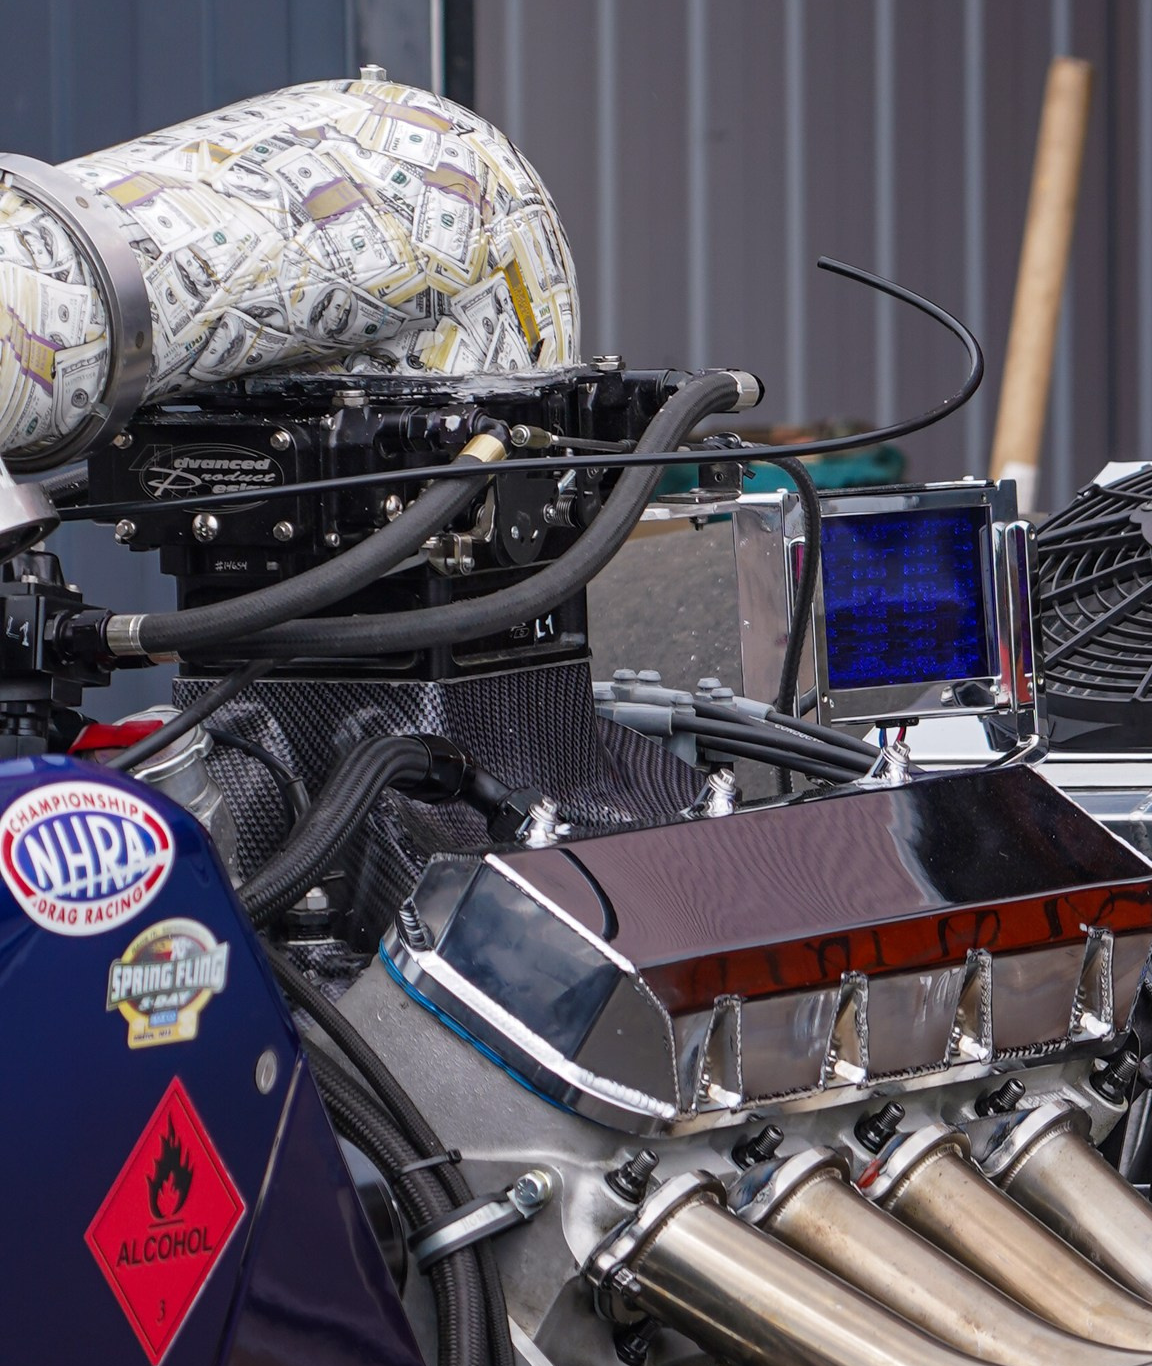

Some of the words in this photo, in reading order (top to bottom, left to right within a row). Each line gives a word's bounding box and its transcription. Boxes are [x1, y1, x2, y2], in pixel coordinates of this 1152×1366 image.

[535, 614, 554, 638] L1
[9, 792, 139, 833] CHAMPIONSHIP
[24, 814, 150, 898] NHRA
[38, 898, 78, 925] DRAG
[85, 886, 143, 925] RACING
[110, 961, 174, 1003] SPRING
[175, 952, 225, 990] FLING
[116, 1227, 212, 1268] ALCOHOL
[156, 1299, 166, 1322] 3
